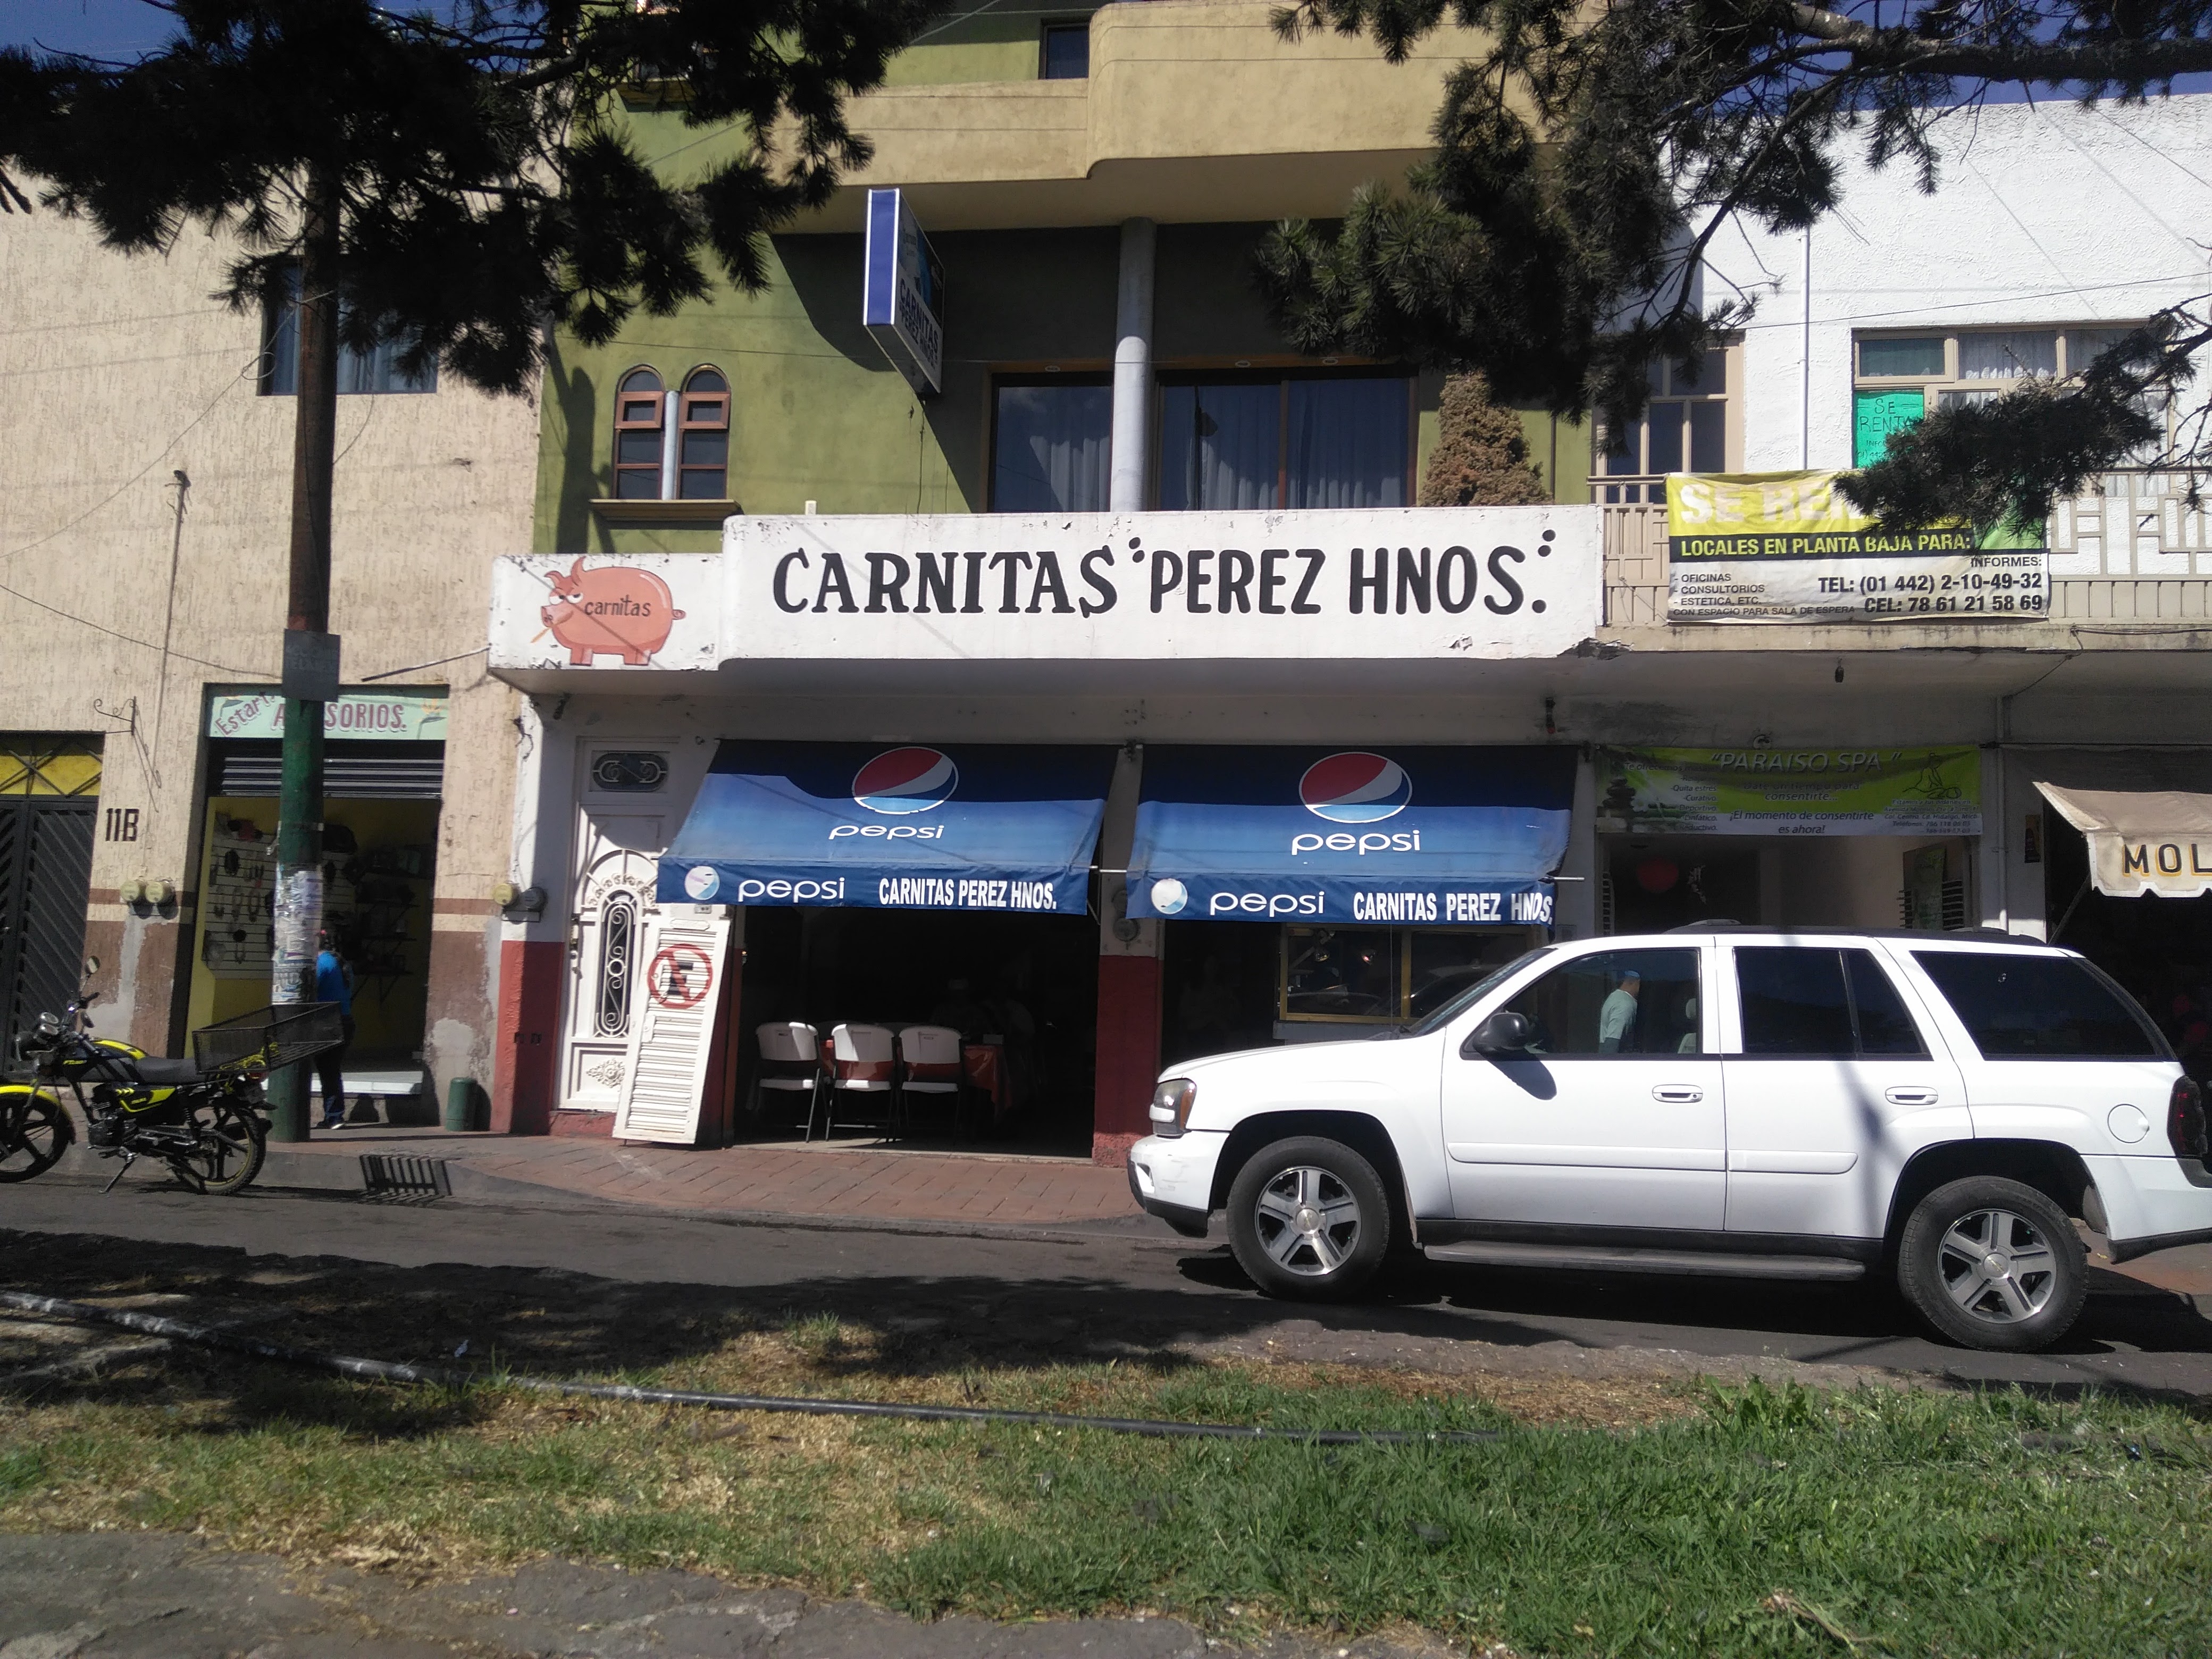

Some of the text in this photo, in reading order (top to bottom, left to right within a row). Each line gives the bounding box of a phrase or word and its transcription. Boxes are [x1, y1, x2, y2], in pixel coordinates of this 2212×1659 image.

[900, 278, 938, 354] CARNITAS
[1874, 398, 1896, 414] SE
[1859, 415, 1911, 433] RENTA
[1680, 483, 1745, 524] SE
[1681, 533, 1970, 557] LOCALES EN PLANTA BAJA PARA:
[1970, 557, 2042, 568] INFORMES:
[772, 546, 1118, 619] CARNITAS
[1681, 573, 1731, 583] OFICINAS
[1818, 572, 2042, 596] TEL: (01 442) 2-10-49-32
[1681, 584, 1765, 594] CONSULTORIOS
[584, 593, 651, 618] carnitas
[1737, 596, 1762, 606] ETC.
[1864, 594, 2043, 613] CEL: 78 61 21 58 69
[1698, 608, 1740, 616] ESPACIO
[1772, 607, 1798, 615] SALA
[1815, 606, 1855, 614] ESPERA
[1791, 783, 1831, 791] tiempo
[1745, 811, 1798, 820] momento
[1799, 811, 1813, 820] de
[1814, 811, 1874, 820] consentirte
[829, 824, 945, 840] pepsi
[1792, 825, 1826, 834] ahora!
[1291, 829, 1420, 856] pepsi
[738, 876, 845, 903] pepsi
[879, 877, 1057, 910] CARNITAS PEREZ HNOS.
[1209, 891, 1325, 917] pepsi
[1353, 891, 1553, 925] CARNITAS PEREZ HNOS.
